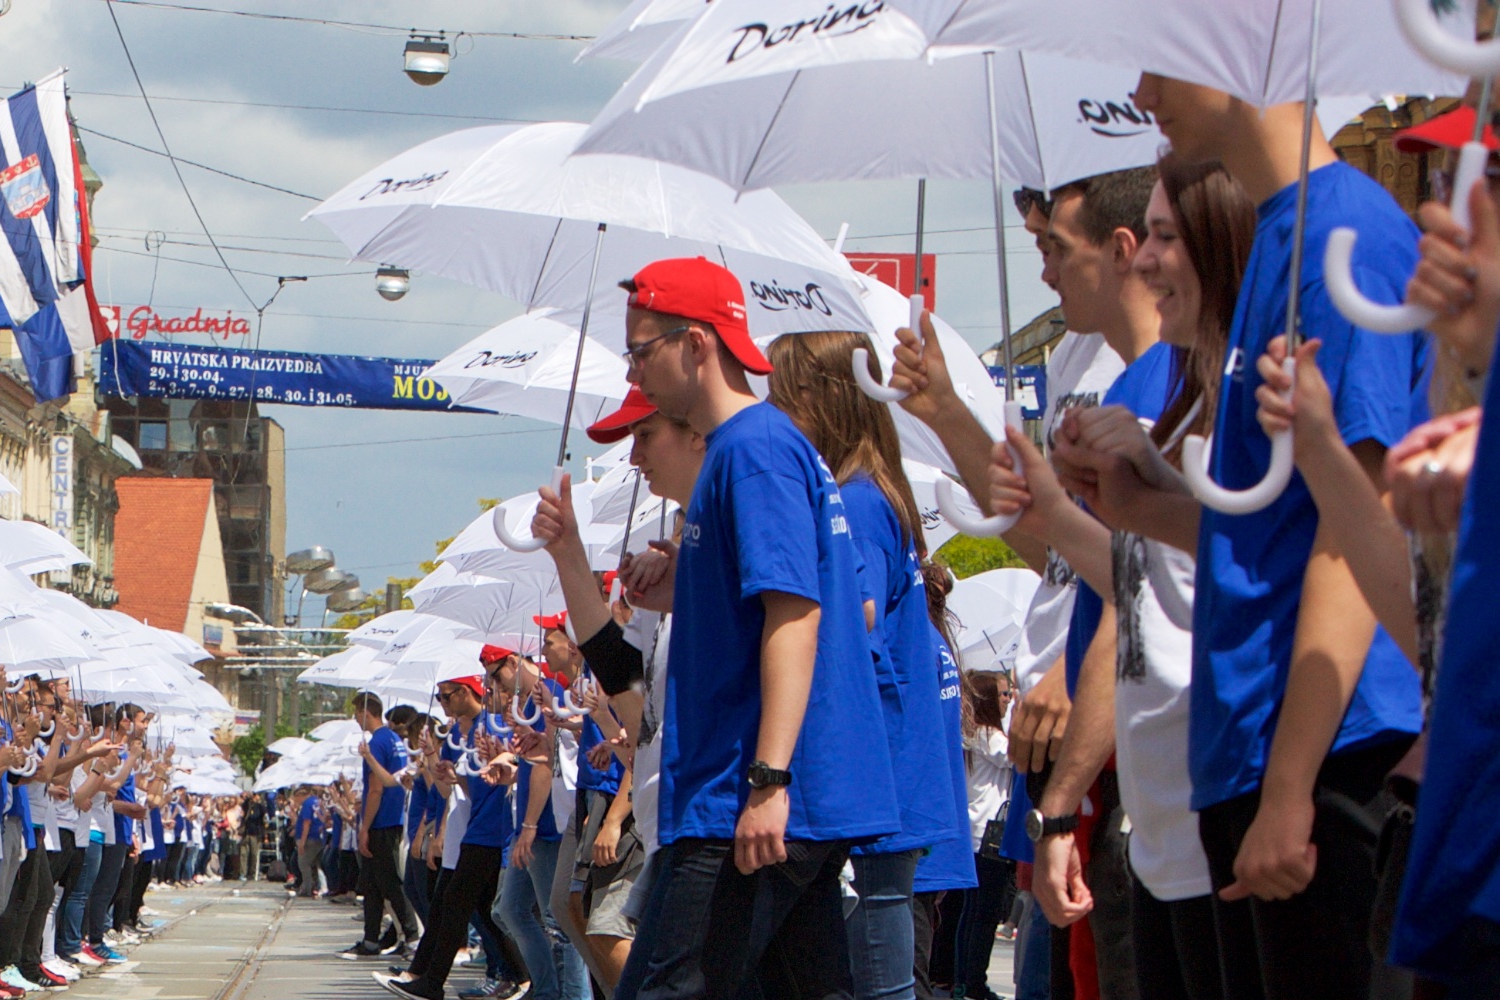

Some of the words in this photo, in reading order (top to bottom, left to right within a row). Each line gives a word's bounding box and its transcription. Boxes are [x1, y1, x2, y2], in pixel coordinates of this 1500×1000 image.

[727, 0, 884, 64] Dorina
[126, 305, 250, 340] Gradnja
[150, 366, 170, 380] 29.
[173, 366, 180, 378] i
[181, 368, 224, 384] 30.04.
[151, 350, 228, 368] HRVATSKA
[232, 355, 323, 375] PRAIZVEDBA
[309, 388, 315, 401] i
